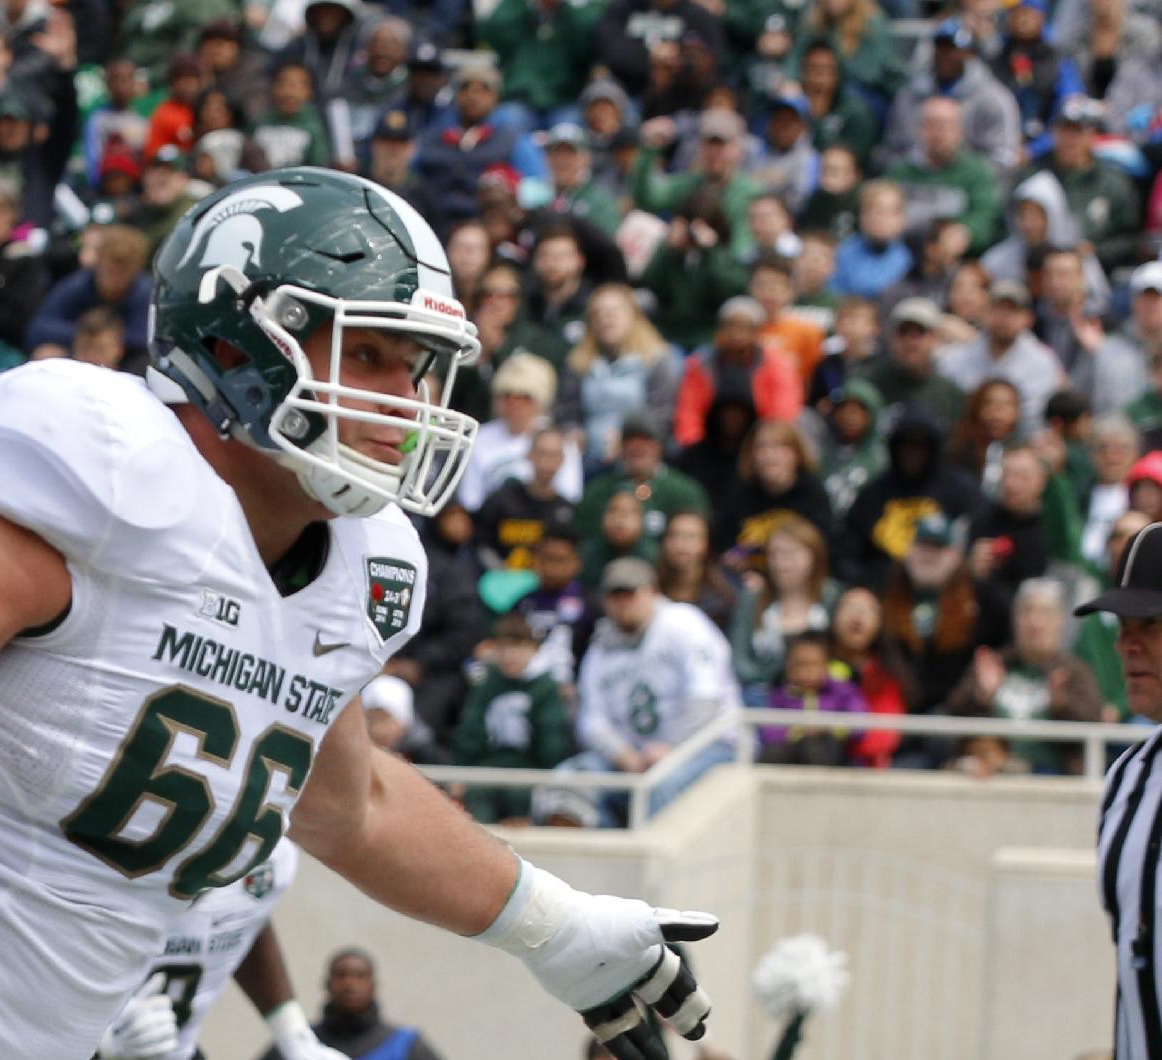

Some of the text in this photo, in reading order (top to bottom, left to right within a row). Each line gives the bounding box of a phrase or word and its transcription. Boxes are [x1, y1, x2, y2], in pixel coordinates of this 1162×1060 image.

[370, 561, 416, 584] CHAMPIONS
[152, 622, 286, 704] MICHIGAN
[59, 682, 314, 901] 66
